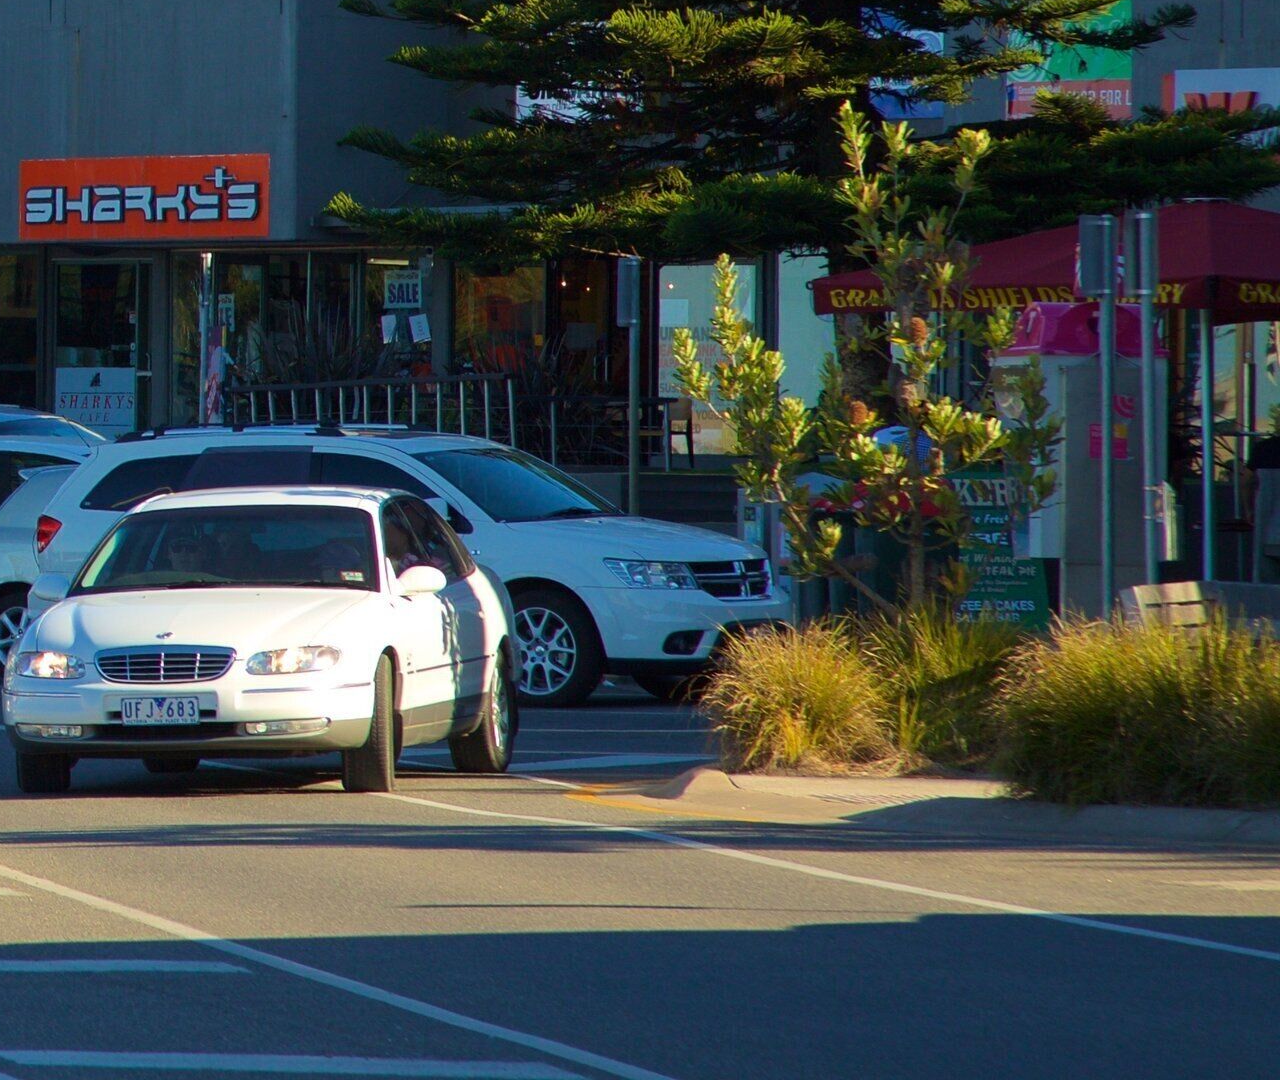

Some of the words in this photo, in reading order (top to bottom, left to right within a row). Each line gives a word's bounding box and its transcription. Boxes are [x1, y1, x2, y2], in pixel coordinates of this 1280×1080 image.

[1099, 89, 1123, 106] FOR
[388, 282, 419, 304] SALE
[59, 394, 134, 410] SHARKYS
[994, 600, 1036, 612] CAKES
[124, 700, 154, 719] UFJ
[166, 700, 196, 718] 683
